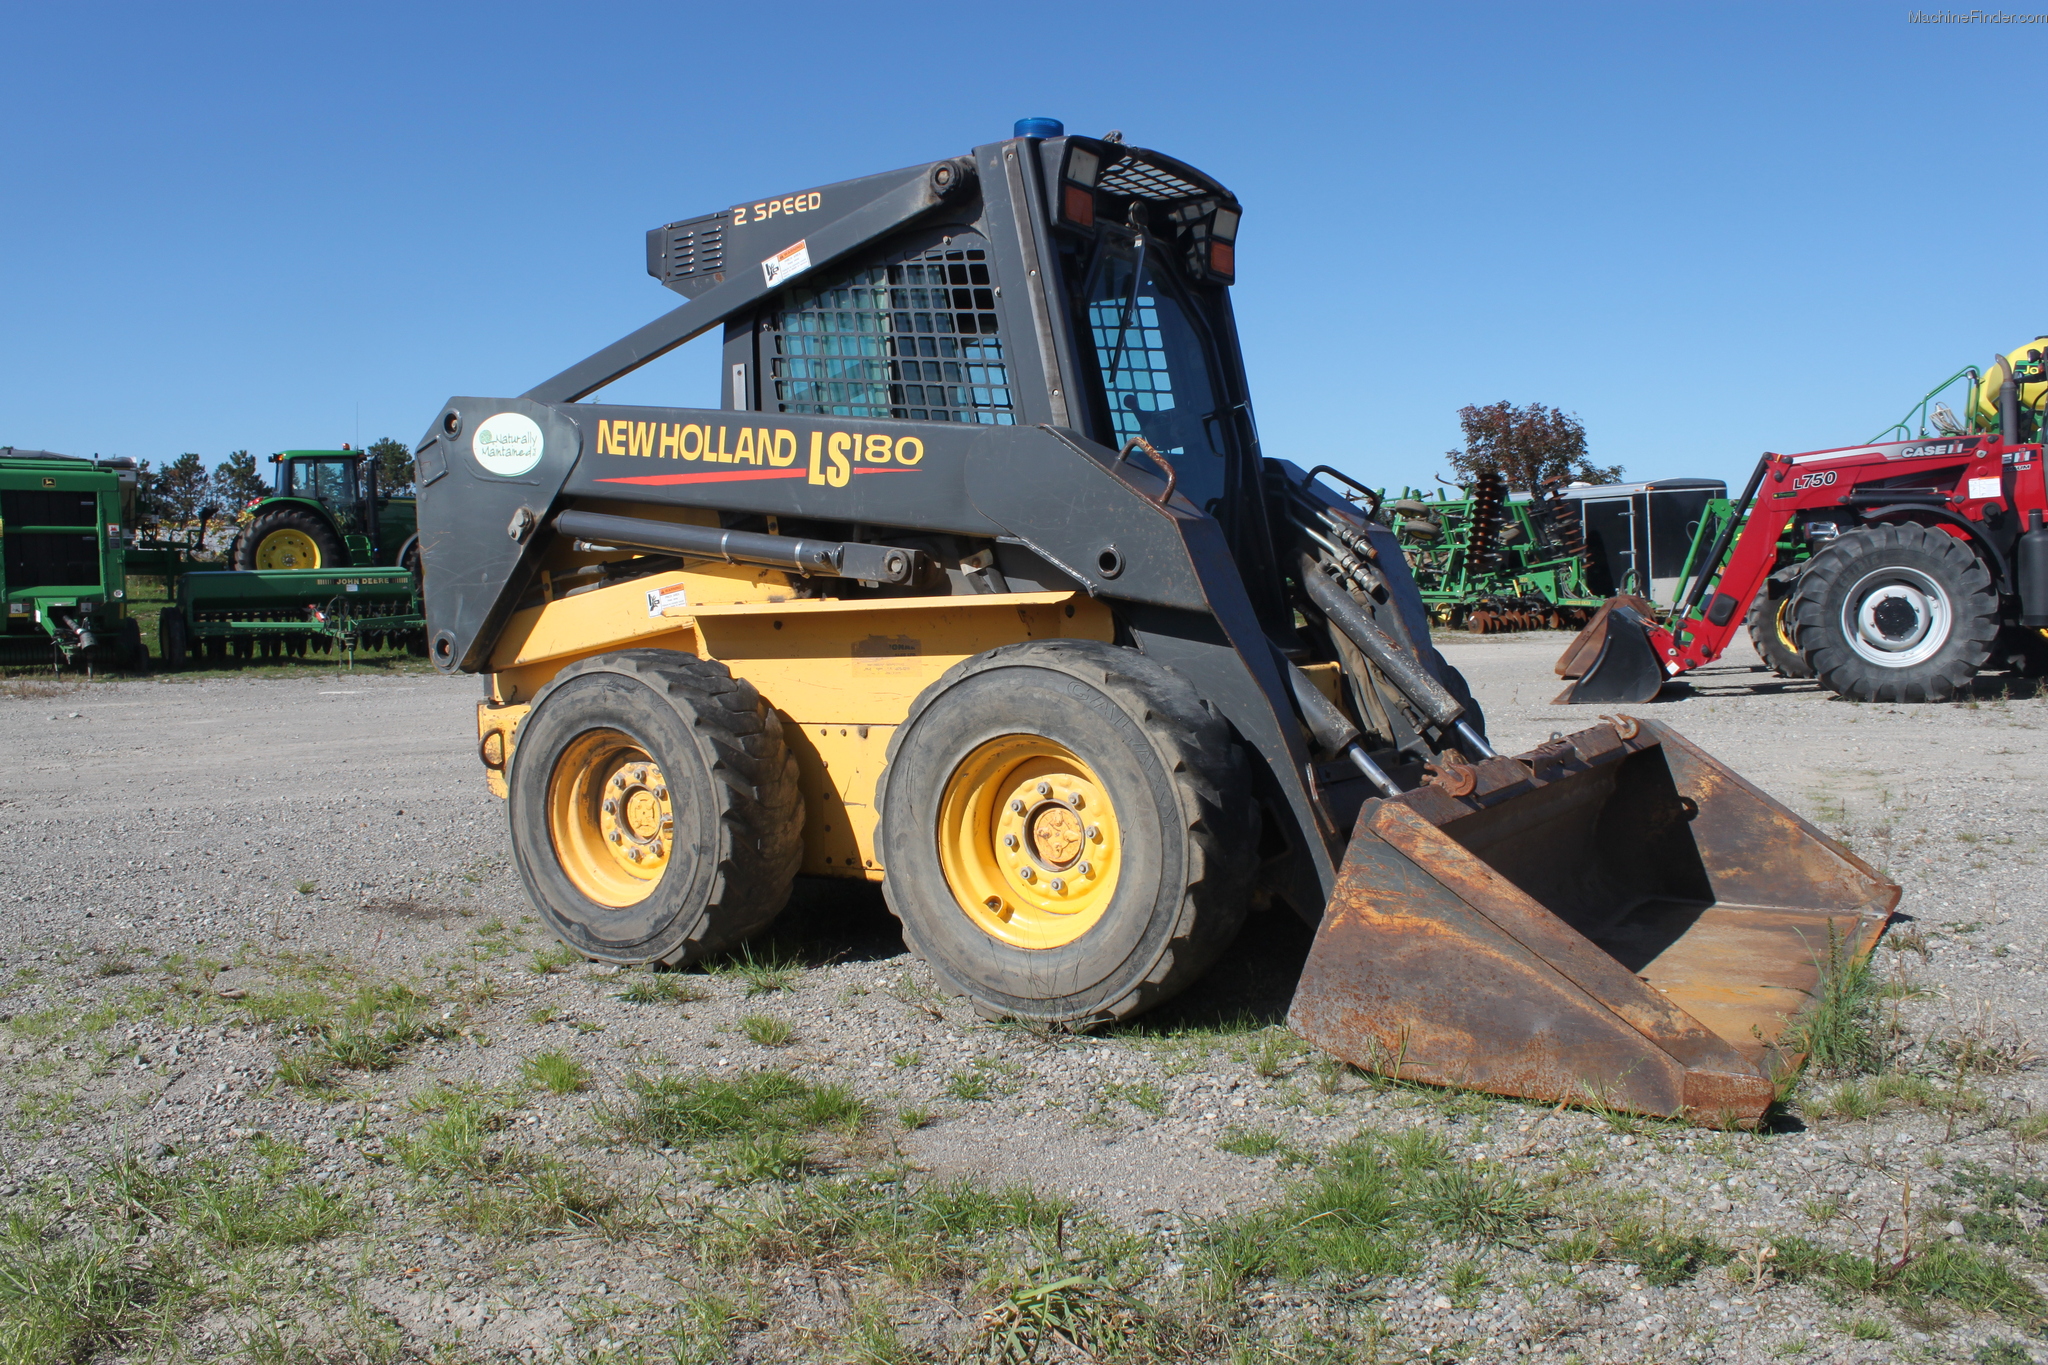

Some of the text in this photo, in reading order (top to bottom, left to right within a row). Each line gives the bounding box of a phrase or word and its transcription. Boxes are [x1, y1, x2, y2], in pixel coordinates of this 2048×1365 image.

[733, 192, 821, 226] 2 SPEED
[495, 431, 538, 446] Naturally
[597, 419, 657, 456] NEW
[659, 422, 797, 467] HOLLAND
[481, 447, 532, 458] Maintained
[1901, 445, 1947, 458] CASE
[1792, 470, 1838, 490] L750
[361, 577, 390, 585] DEERE
